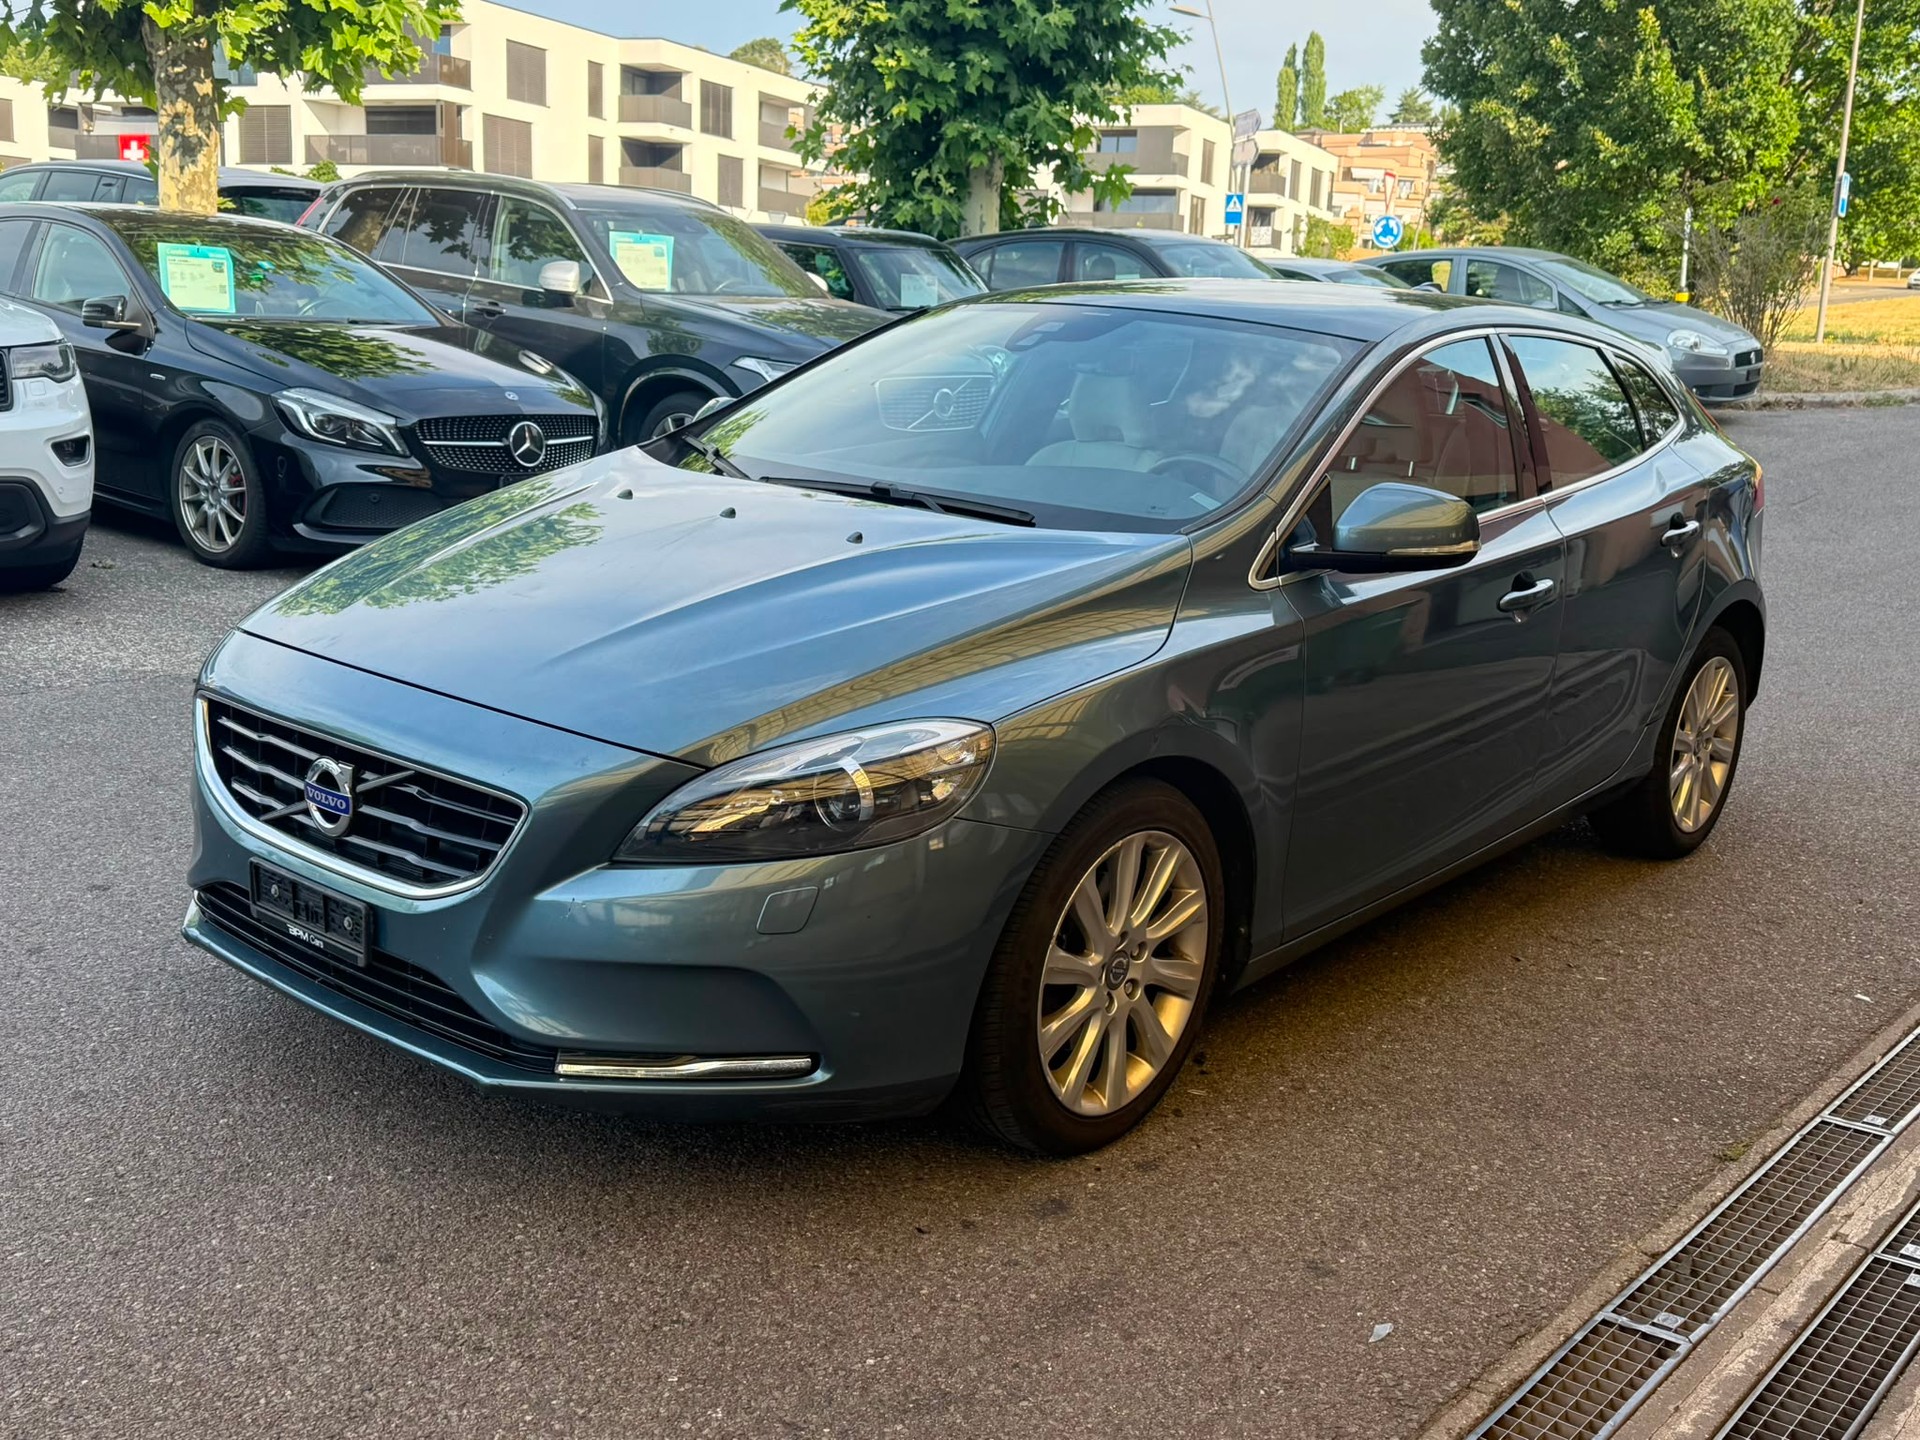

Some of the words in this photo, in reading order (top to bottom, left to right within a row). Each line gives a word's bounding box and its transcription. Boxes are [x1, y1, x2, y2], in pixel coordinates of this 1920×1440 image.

[306, 786, 346, 810] VOLVO
[286, 923, 309, 942] BPM
[310, 934, 324, 949] Cars
